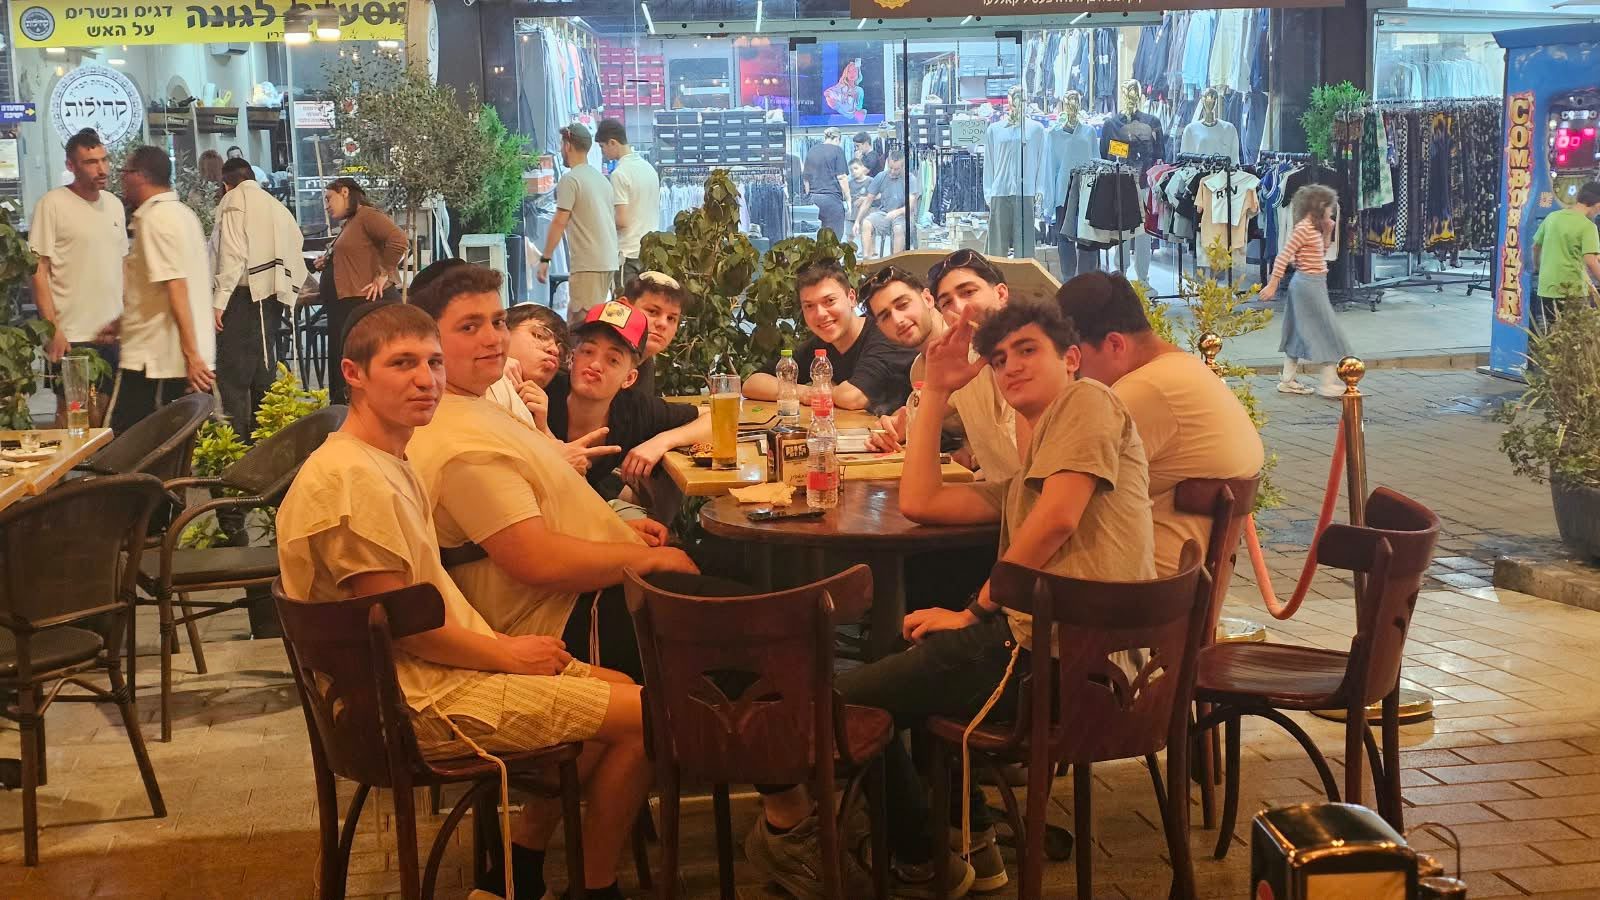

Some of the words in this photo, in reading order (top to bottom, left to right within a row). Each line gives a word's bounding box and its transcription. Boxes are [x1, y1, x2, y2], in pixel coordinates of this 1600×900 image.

[65, 6, 128, 19] ובשרים
[134, 5, 173, 18] דגים
[186, 0, 276, 28] לגונה
[292, 1, 407, 27] מסע
[87, 25, 127, 38] האש
[132, 22, 155, 37] על
[64, 97, 127, 120] קהילות
